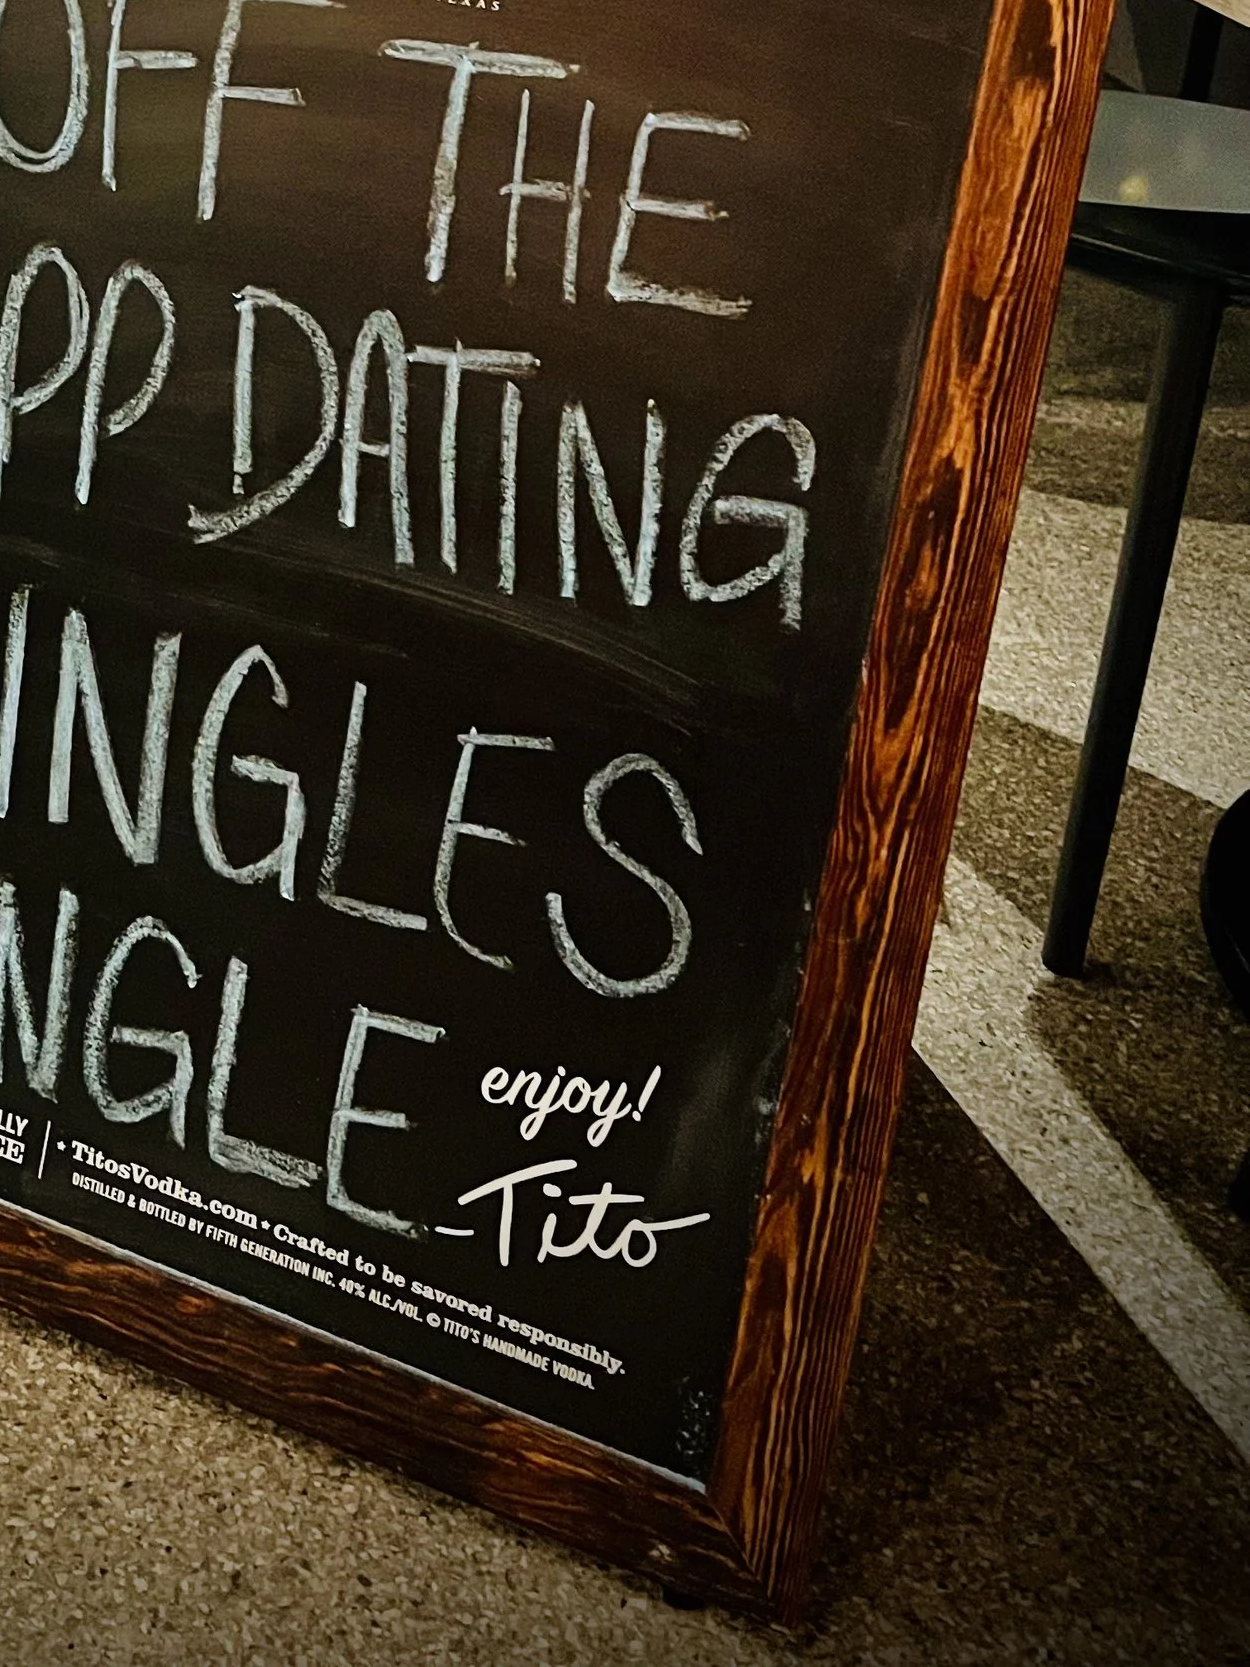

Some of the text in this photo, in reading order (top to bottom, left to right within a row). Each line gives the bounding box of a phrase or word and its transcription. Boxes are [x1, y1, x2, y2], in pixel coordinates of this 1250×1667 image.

[377, 37, 753, 320] THE
[187, 284, 818, 636] DATING
[480, 1065, 662, 1147] enjoy!
[71, 1139, 626, 1375] TitosVodka.com Crafted to be savored responsibly.
[71, 1172, 125, 1205] DISTILLED
[126, 1194, 137, 1208] &
[138, 1198, 186, 1229] BOTTLED
[188, 1217, 205, 1234] BY
[206, 1223, 238, 1249] FIFTH
[240, 1236, 311, 1277] GENERATION
[311, 1265, 336, 1288] INC.
[338, 1277, 366, 1299] 40%
[443, 1317, 480, 1345] TITO'S
[482, 1334, 550, 1372] HANDMADE
